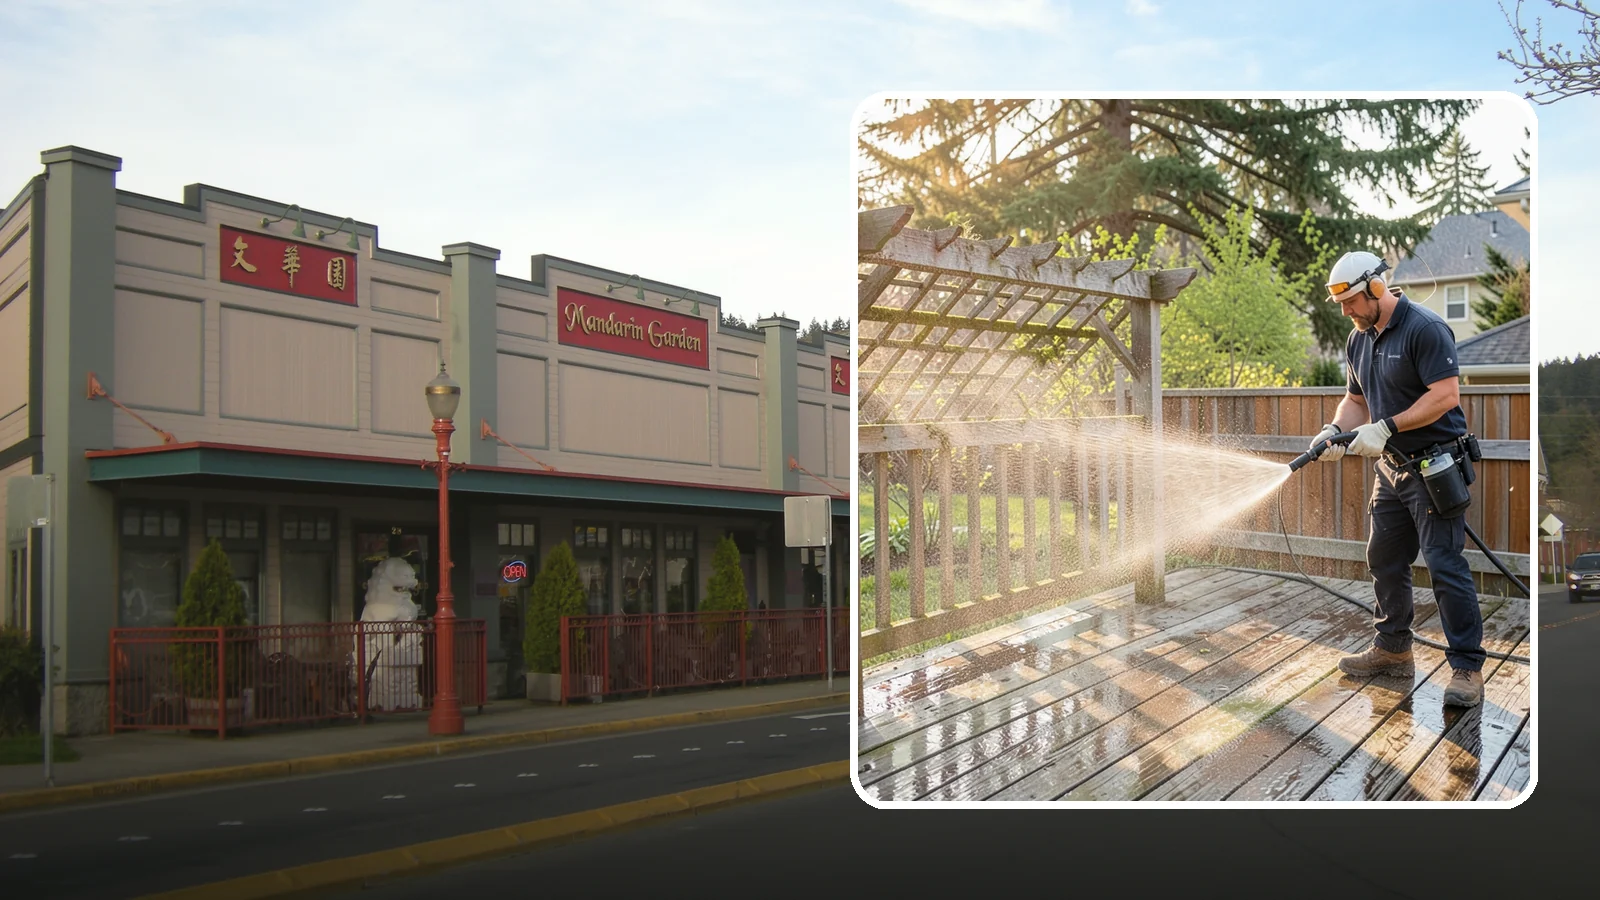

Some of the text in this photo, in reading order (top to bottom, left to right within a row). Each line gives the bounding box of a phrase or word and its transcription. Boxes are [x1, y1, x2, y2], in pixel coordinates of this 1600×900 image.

[230, 235, 347, 290] 文華園
[564, 302, 702, 352] Mandarin Garden
[503, 565, 527, 578] OPEN
